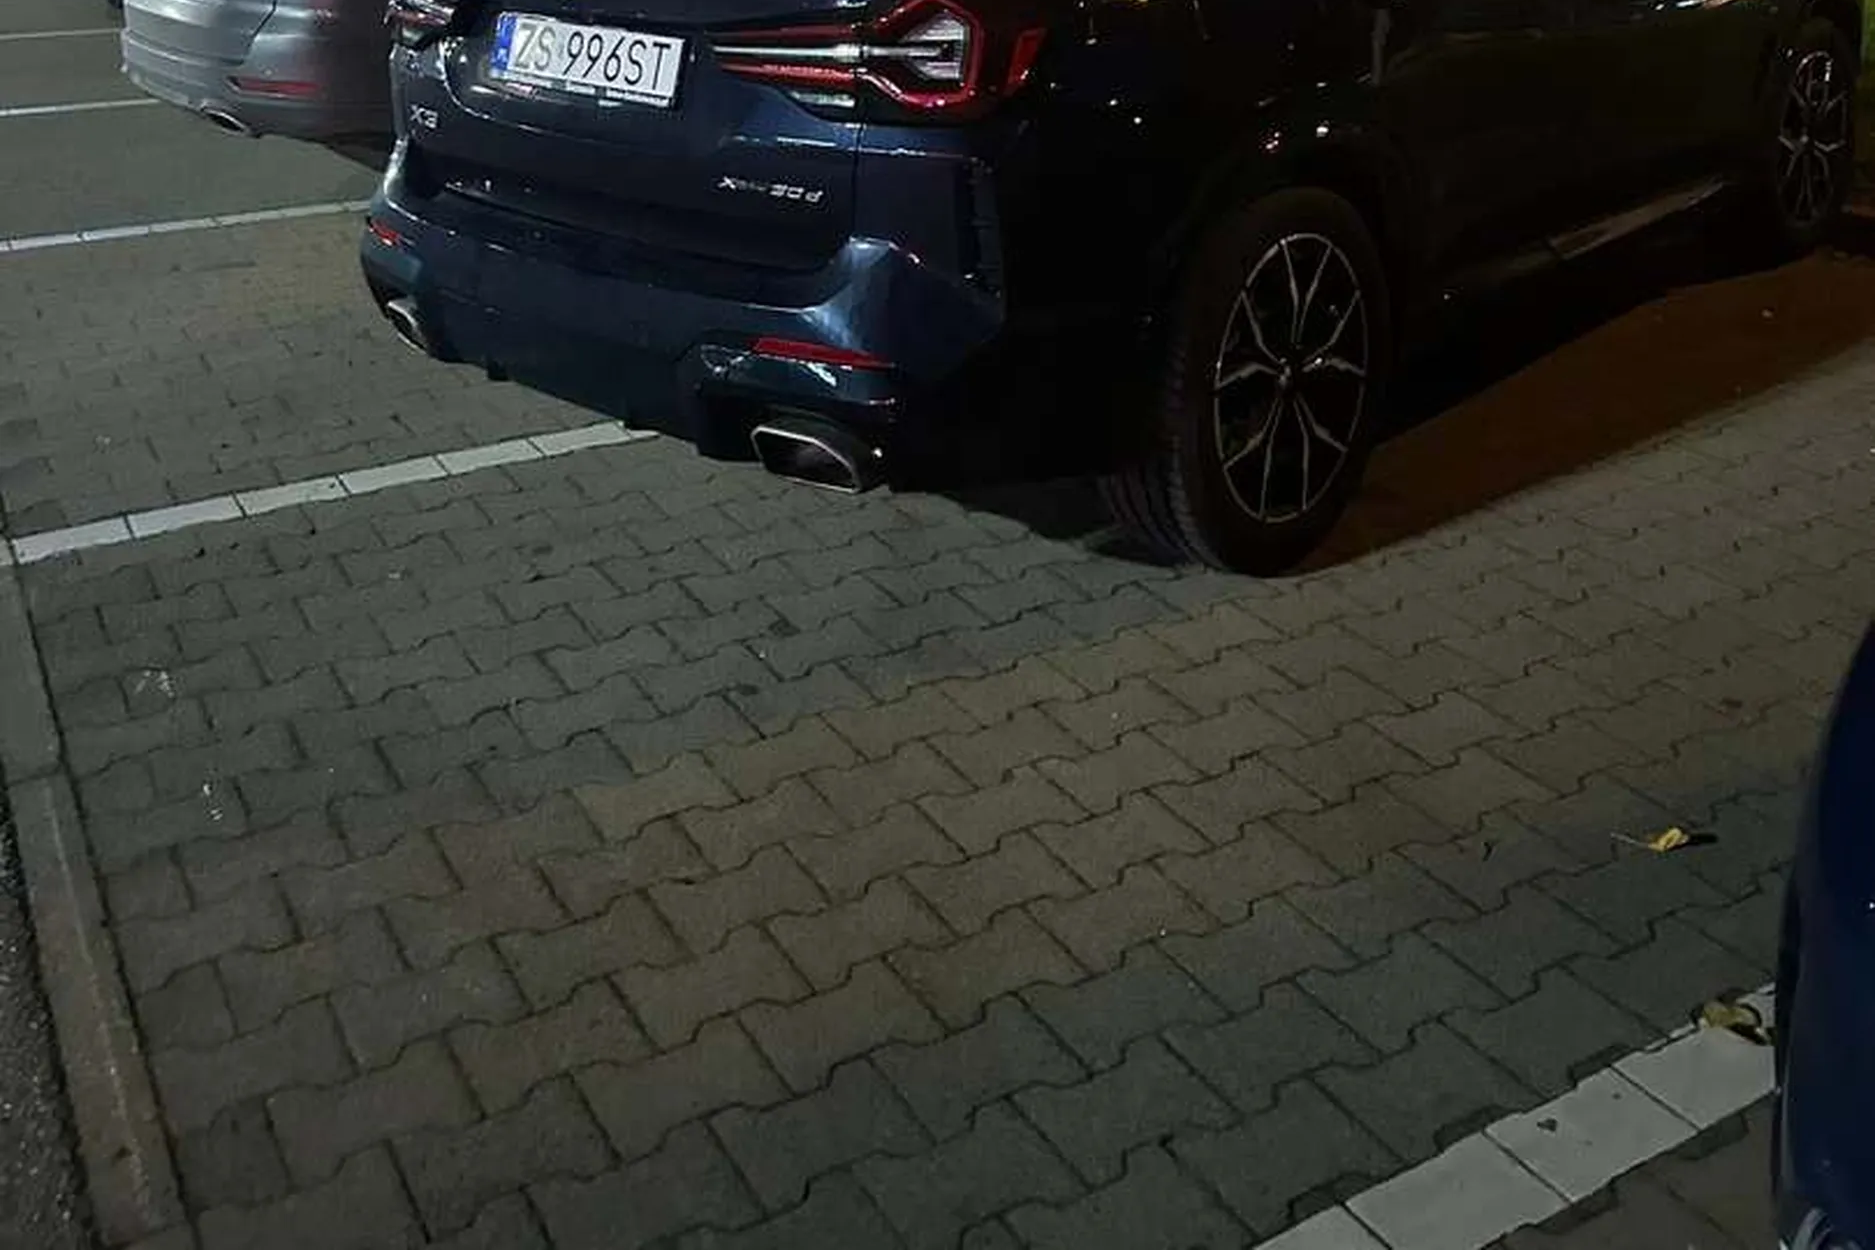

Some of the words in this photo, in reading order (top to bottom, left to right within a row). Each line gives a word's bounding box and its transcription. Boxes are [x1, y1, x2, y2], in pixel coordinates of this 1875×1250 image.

[514, 22, 557, 71] ZS
[562, 31, 672, 91] 996ST
[410, 104, 438, 129] X3
